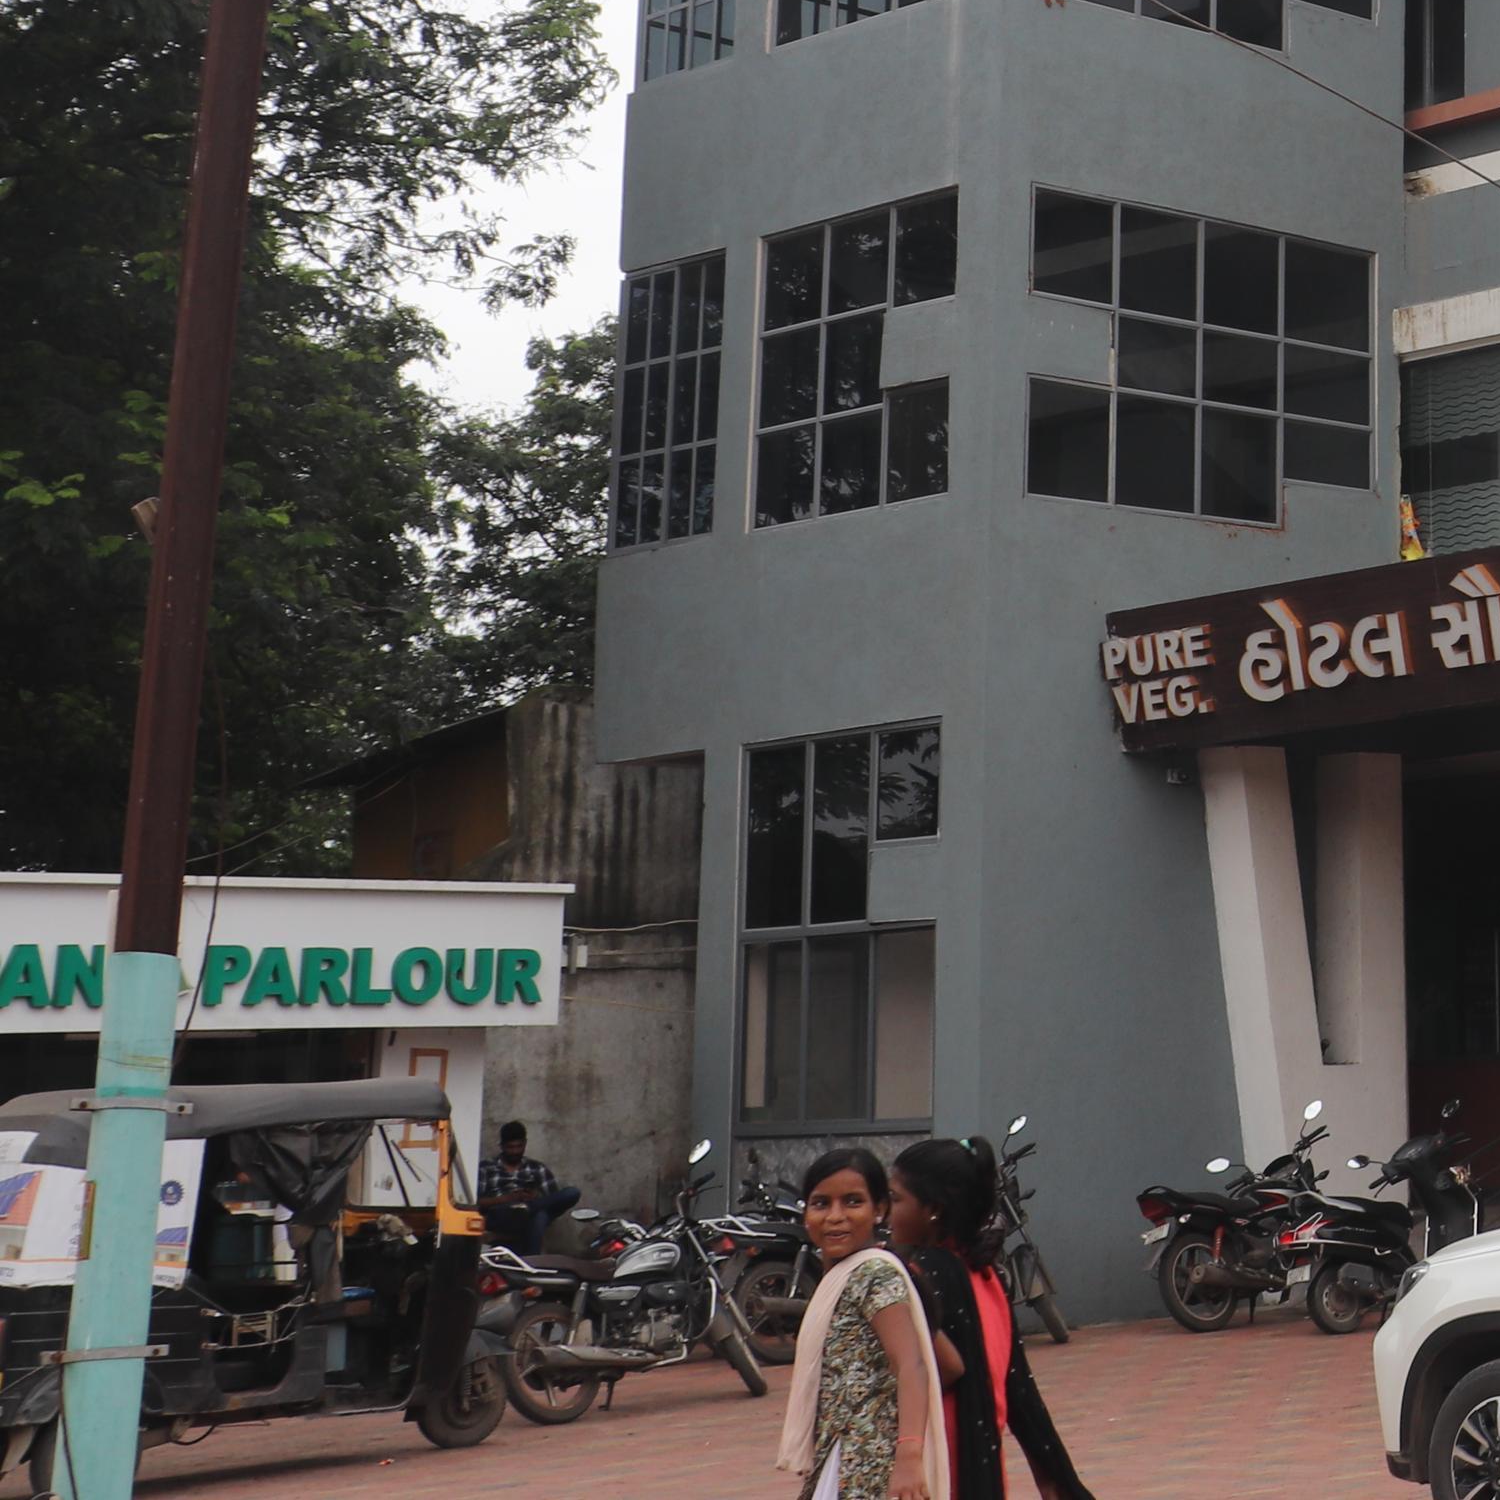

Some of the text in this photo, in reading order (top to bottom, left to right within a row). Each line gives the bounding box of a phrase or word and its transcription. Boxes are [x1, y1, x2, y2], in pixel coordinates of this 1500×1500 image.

[1102, 624, 1216, 680] PURE
[1239, 598, 1414, 703] હોટલ
[1112, 675, 1216, 724] VEG.
[201, 945, 542, 1007] PARLOUR
